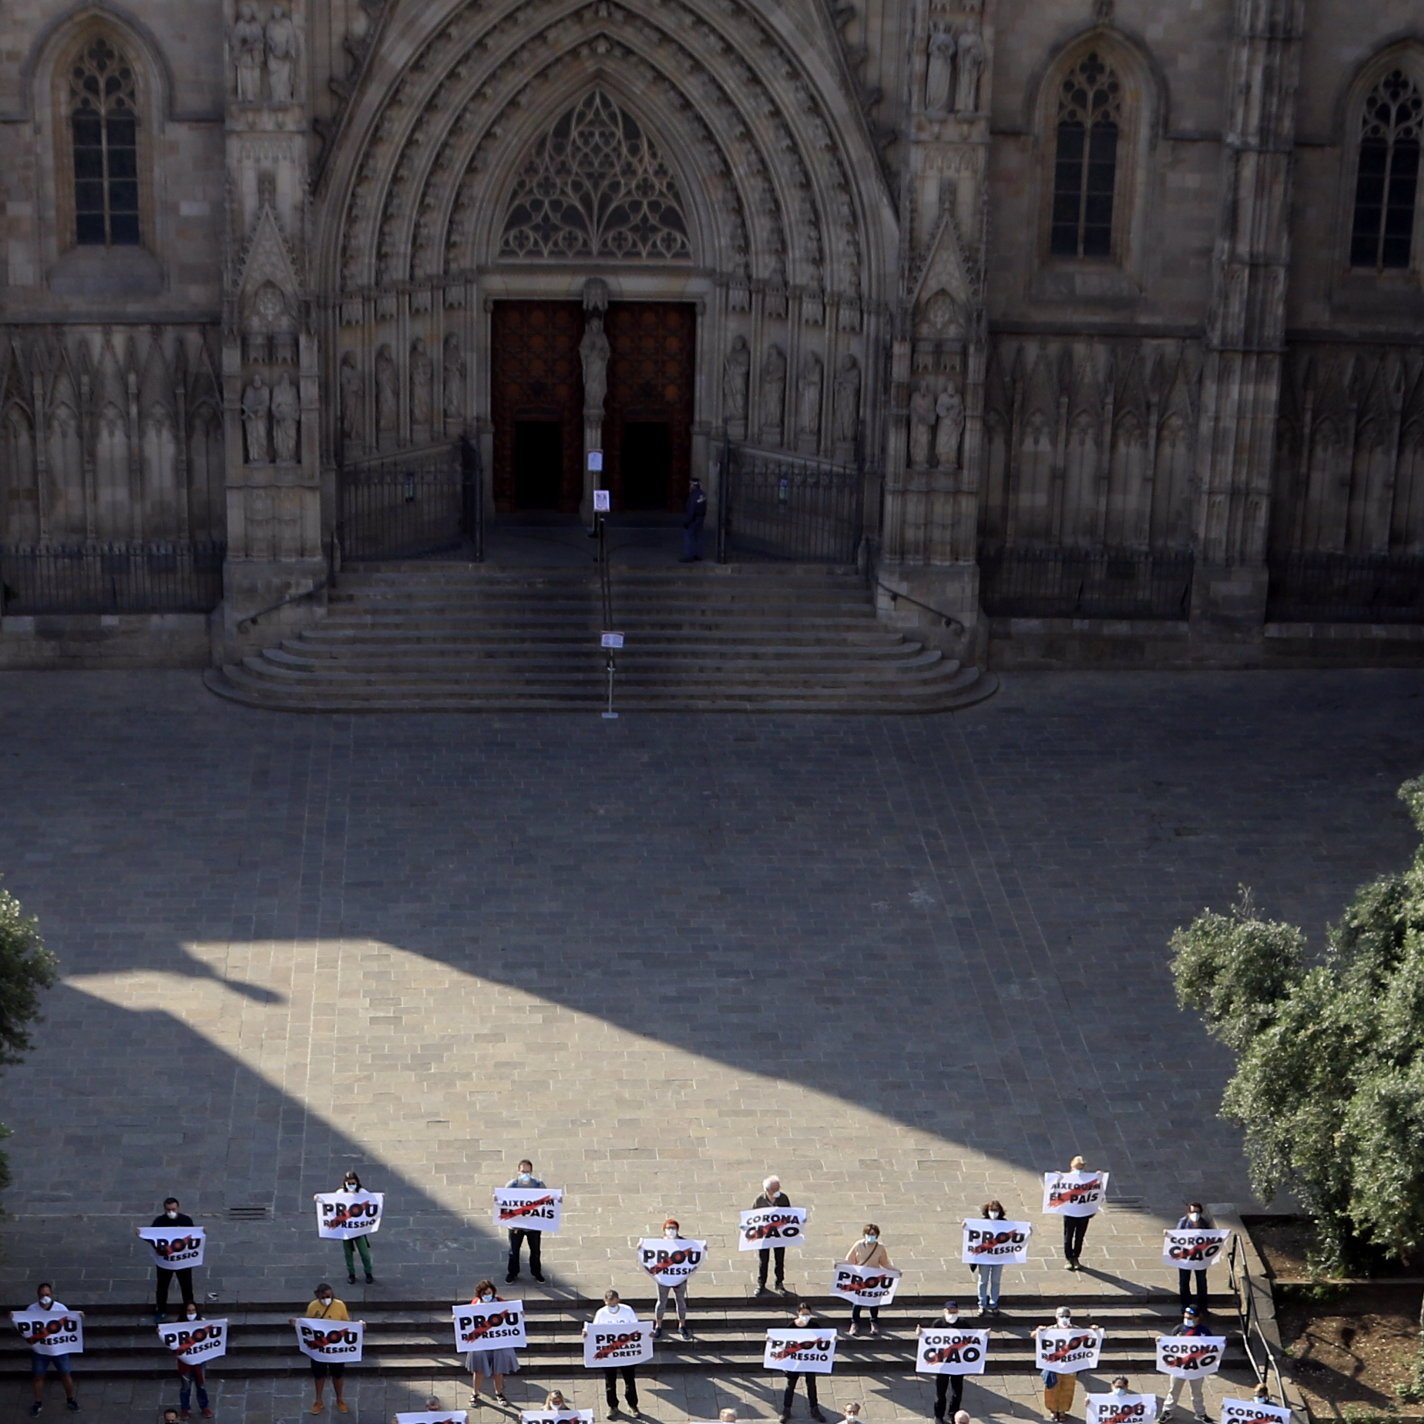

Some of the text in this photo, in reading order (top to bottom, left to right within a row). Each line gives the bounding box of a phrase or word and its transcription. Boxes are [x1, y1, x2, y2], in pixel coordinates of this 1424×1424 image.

[1069, 1192, 1099, 1204] PAÍS
[323, 1203, 378, 1217] PROU
[520, 1208, 554, 1218] PAÍS
[746, 1215, 799, 1224] CORONA
[745, 1226, 799, 1240] CIAO
[968, 1230, 1025, 1244] PROU
[643, 1249, 701, 1264] PROU
[1169, 1246, 1219, 1261] CIAO
[838, 1271, 893, 1289] PROU
[18, 1320, 77, 1334] PROU
[459, 1313, 519, 1330] PROU
[164, 1326, 222, 1346] PROU
[301, 1326, 358, 1344] PROU
[595, 1332, 641, 1344] PROU
[925, 1336, 981, 1345] CORONA
[771, 1340, 830, 1351] PROU
[1042, 1337, 1097, 1351] PROU
[1163, 1345, 1218, 1353] CORONA
[924, 1347, 980, 1364] CIAO
[1162, 1354, 1216, 1370] CIAO
[1099, 1404, 1145, 1415] PROU
[1228, 1407, 1284, 1424] CORONA
